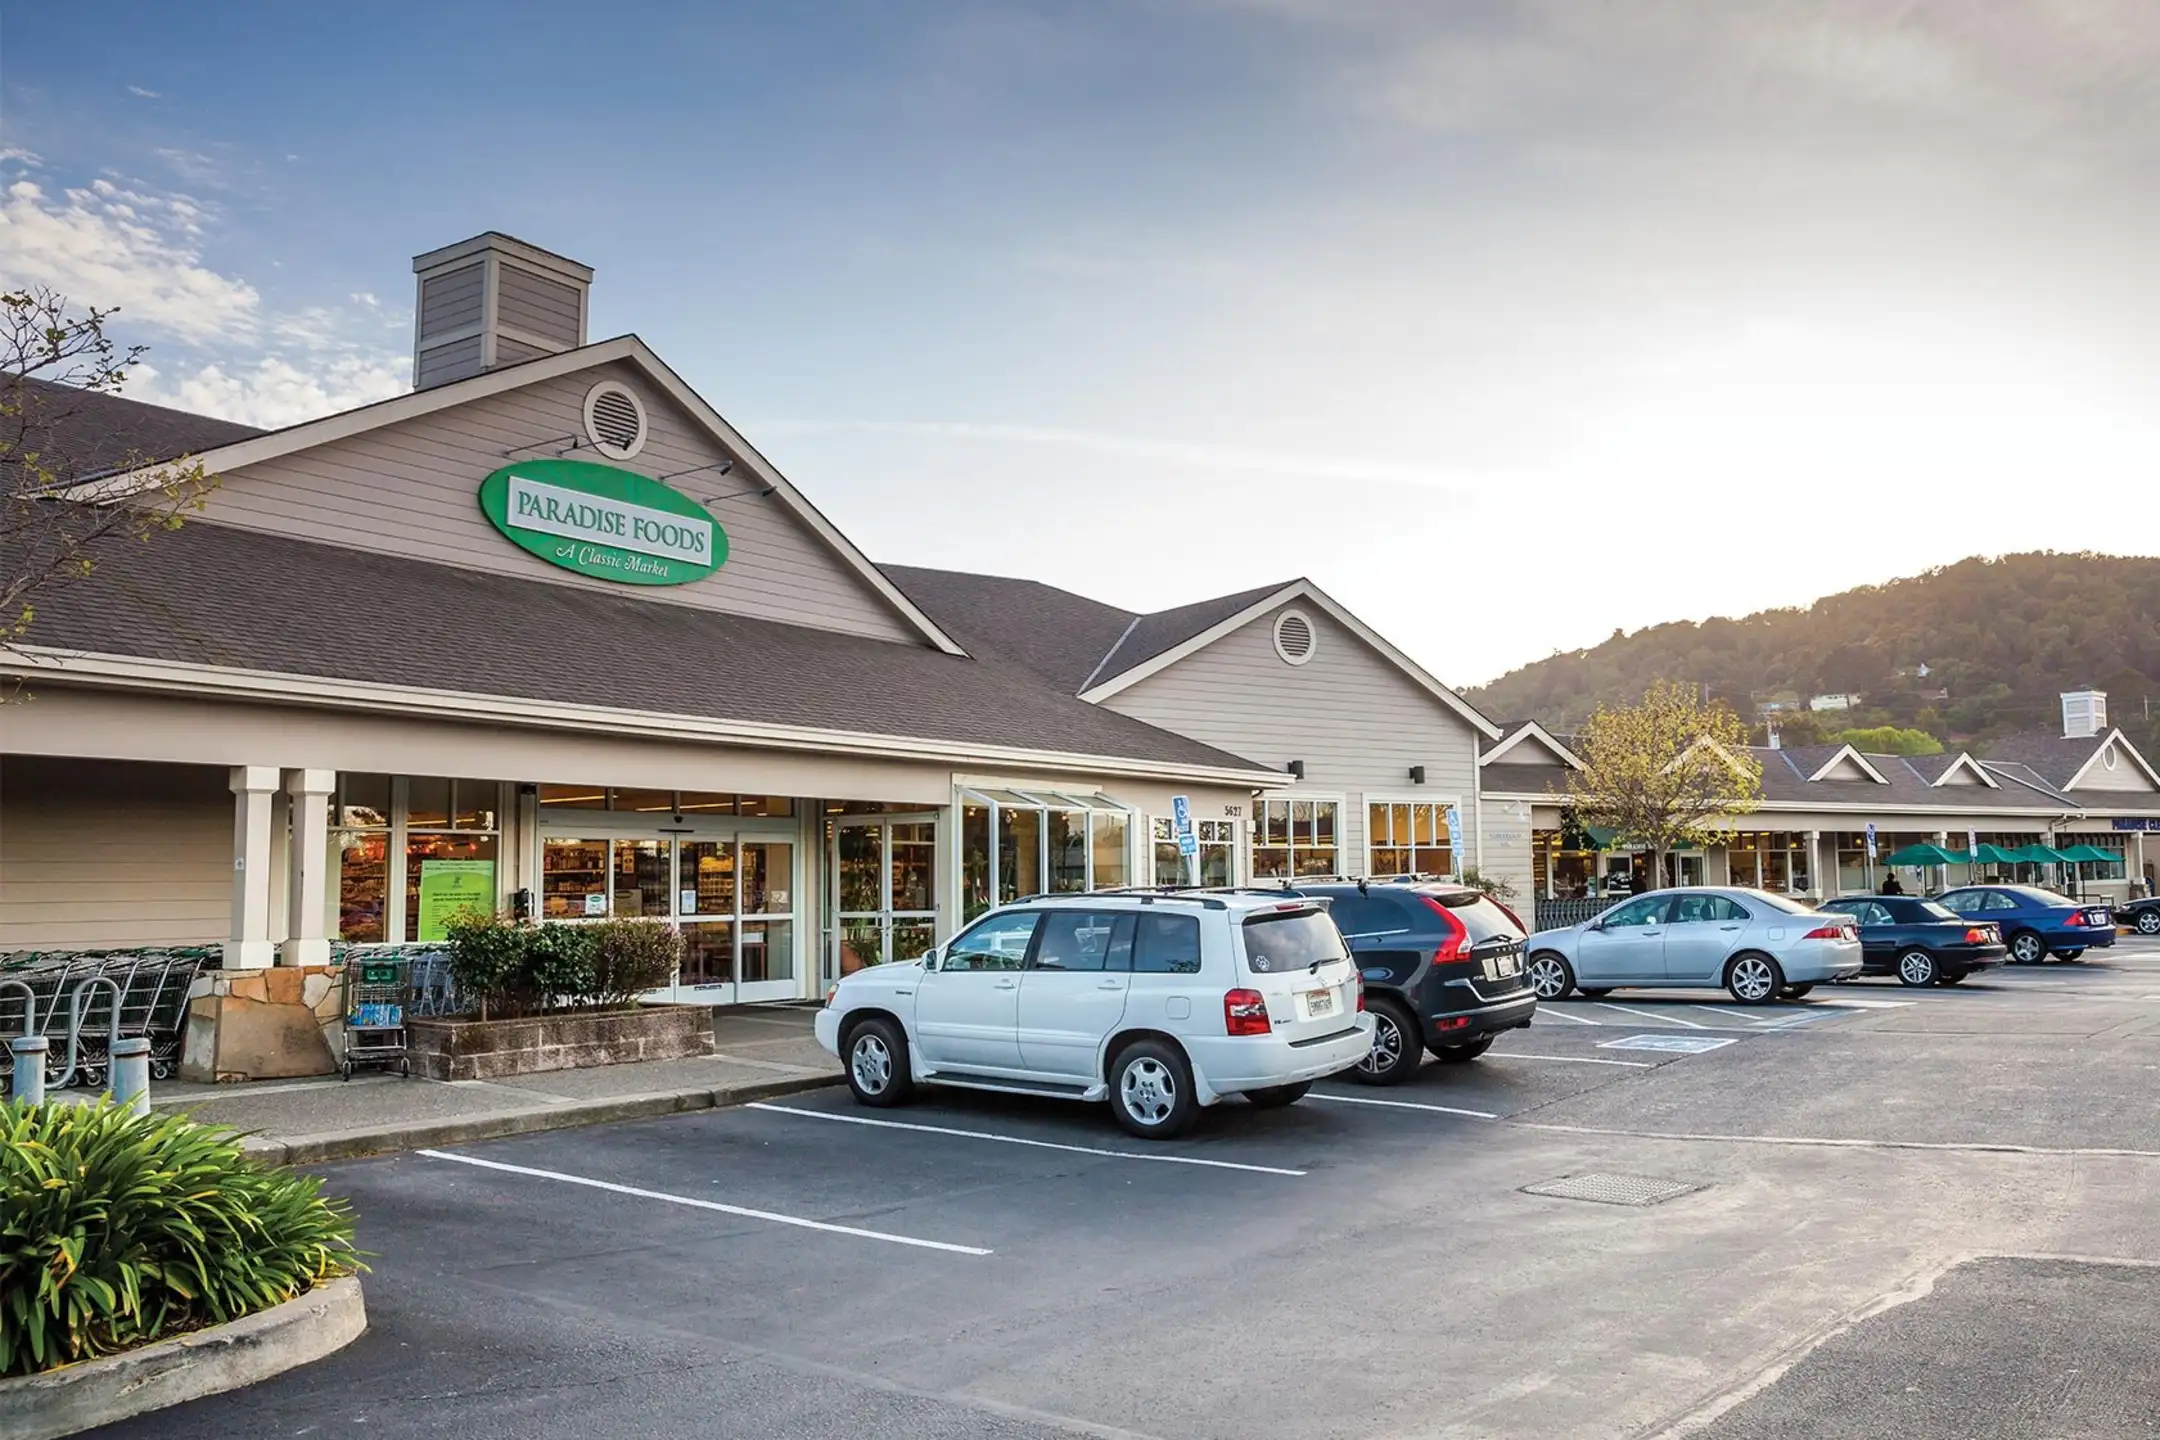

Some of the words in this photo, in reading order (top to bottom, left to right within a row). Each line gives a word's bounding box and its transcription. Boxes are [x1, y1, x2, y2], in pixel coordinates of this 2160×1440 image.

[517, 490, 626, 537] PARADISE
[633, 516, 705, 553] FOODS
[556, 543, 576, 559] A
[578, 546, 621, 568] Classic
[624, 555, 669, 577] Market
